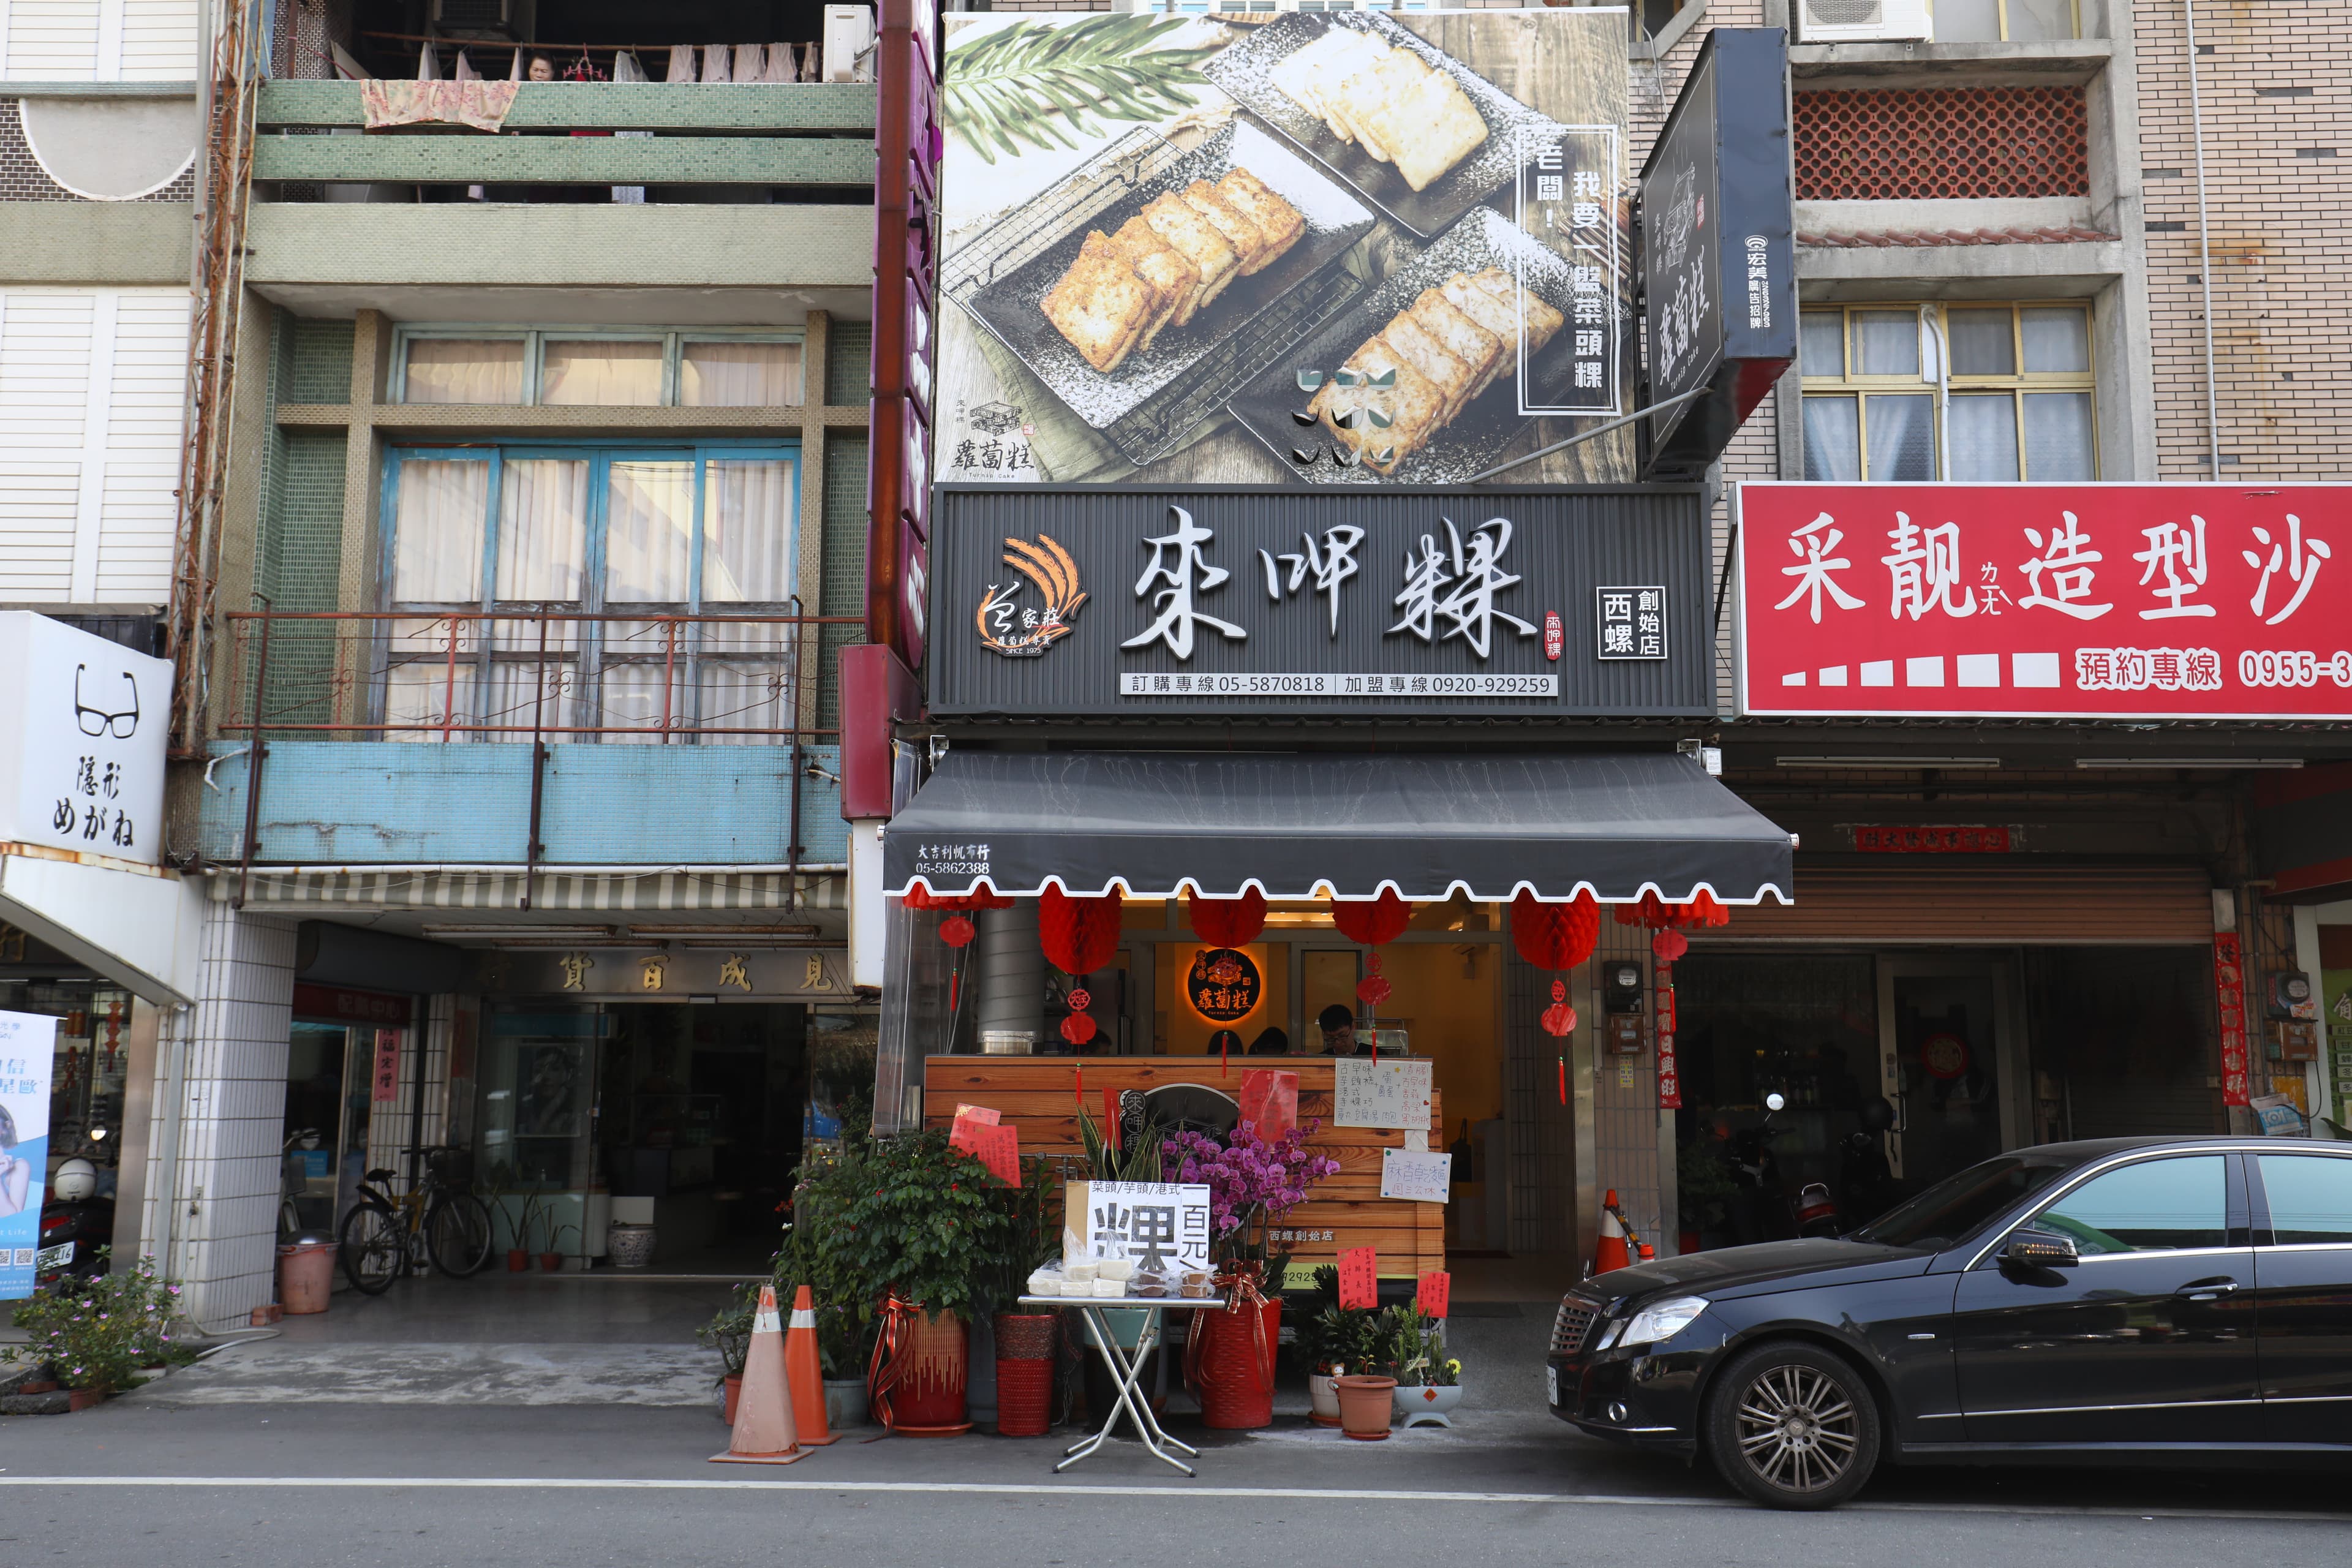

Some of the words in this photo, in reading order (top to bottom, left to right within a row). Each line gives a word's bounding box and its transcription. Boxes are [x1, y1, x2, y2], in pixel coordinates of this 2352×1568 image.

[1572, 170, 1603, 389] 我要一盤菜頭粿
[1747, 252, 1768, 279] 宏美
[951, 439, 1035, 472] 蘿蔔糕
[1120, 505, 1537, 663] 來呷粿
[1603, 594, 1634, 654] 西螺
[1638, 590, 1660, 655] 創始店
[2079, 650, 2218, 687] 預約專線
[77, 755, 121, 801] 隱形
[53, 797, 134, 848] めがね
[916, 862, 990, 875] 05-5862388
[918, 843, 991, 861] 大吉利帆布行
[1092, 1181, 1181, 1195] 菜頭/芋頭/港式
[1094, 1202, 1178, 1271] 粿
[1268, 1230, 1334, 1242] 西螺創始店
